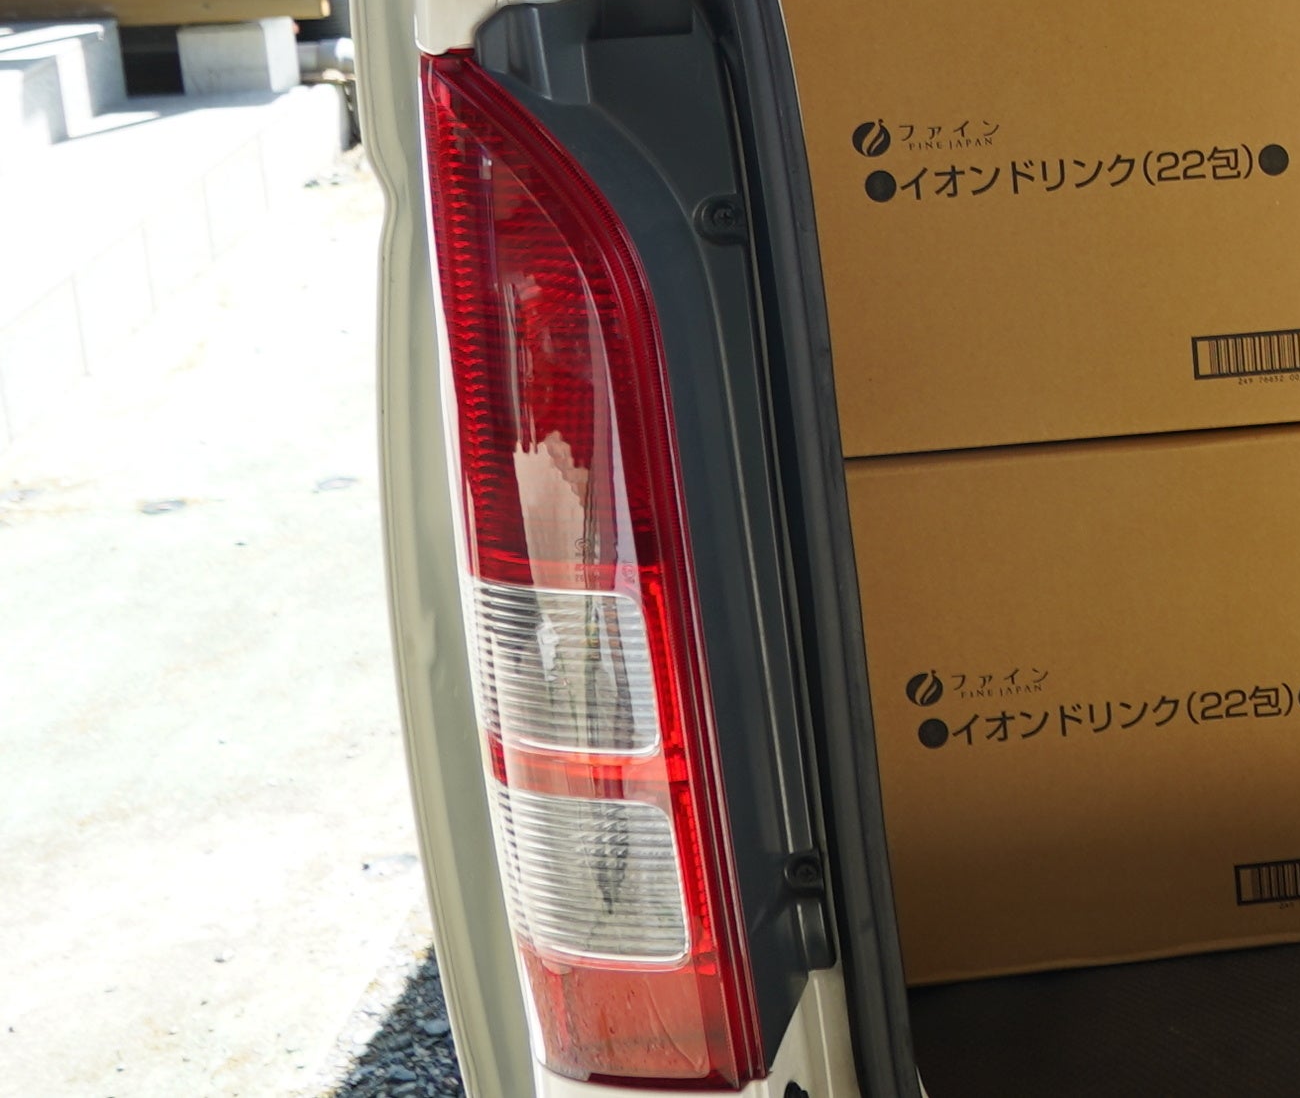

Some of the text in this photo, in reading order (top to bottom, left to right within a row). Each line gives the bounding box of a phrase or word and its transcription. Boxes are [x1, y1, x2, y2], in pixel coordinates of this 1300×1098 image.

[899, 121, 999, 142] ファイン
[952, 668, 1048, 692] ファイン
